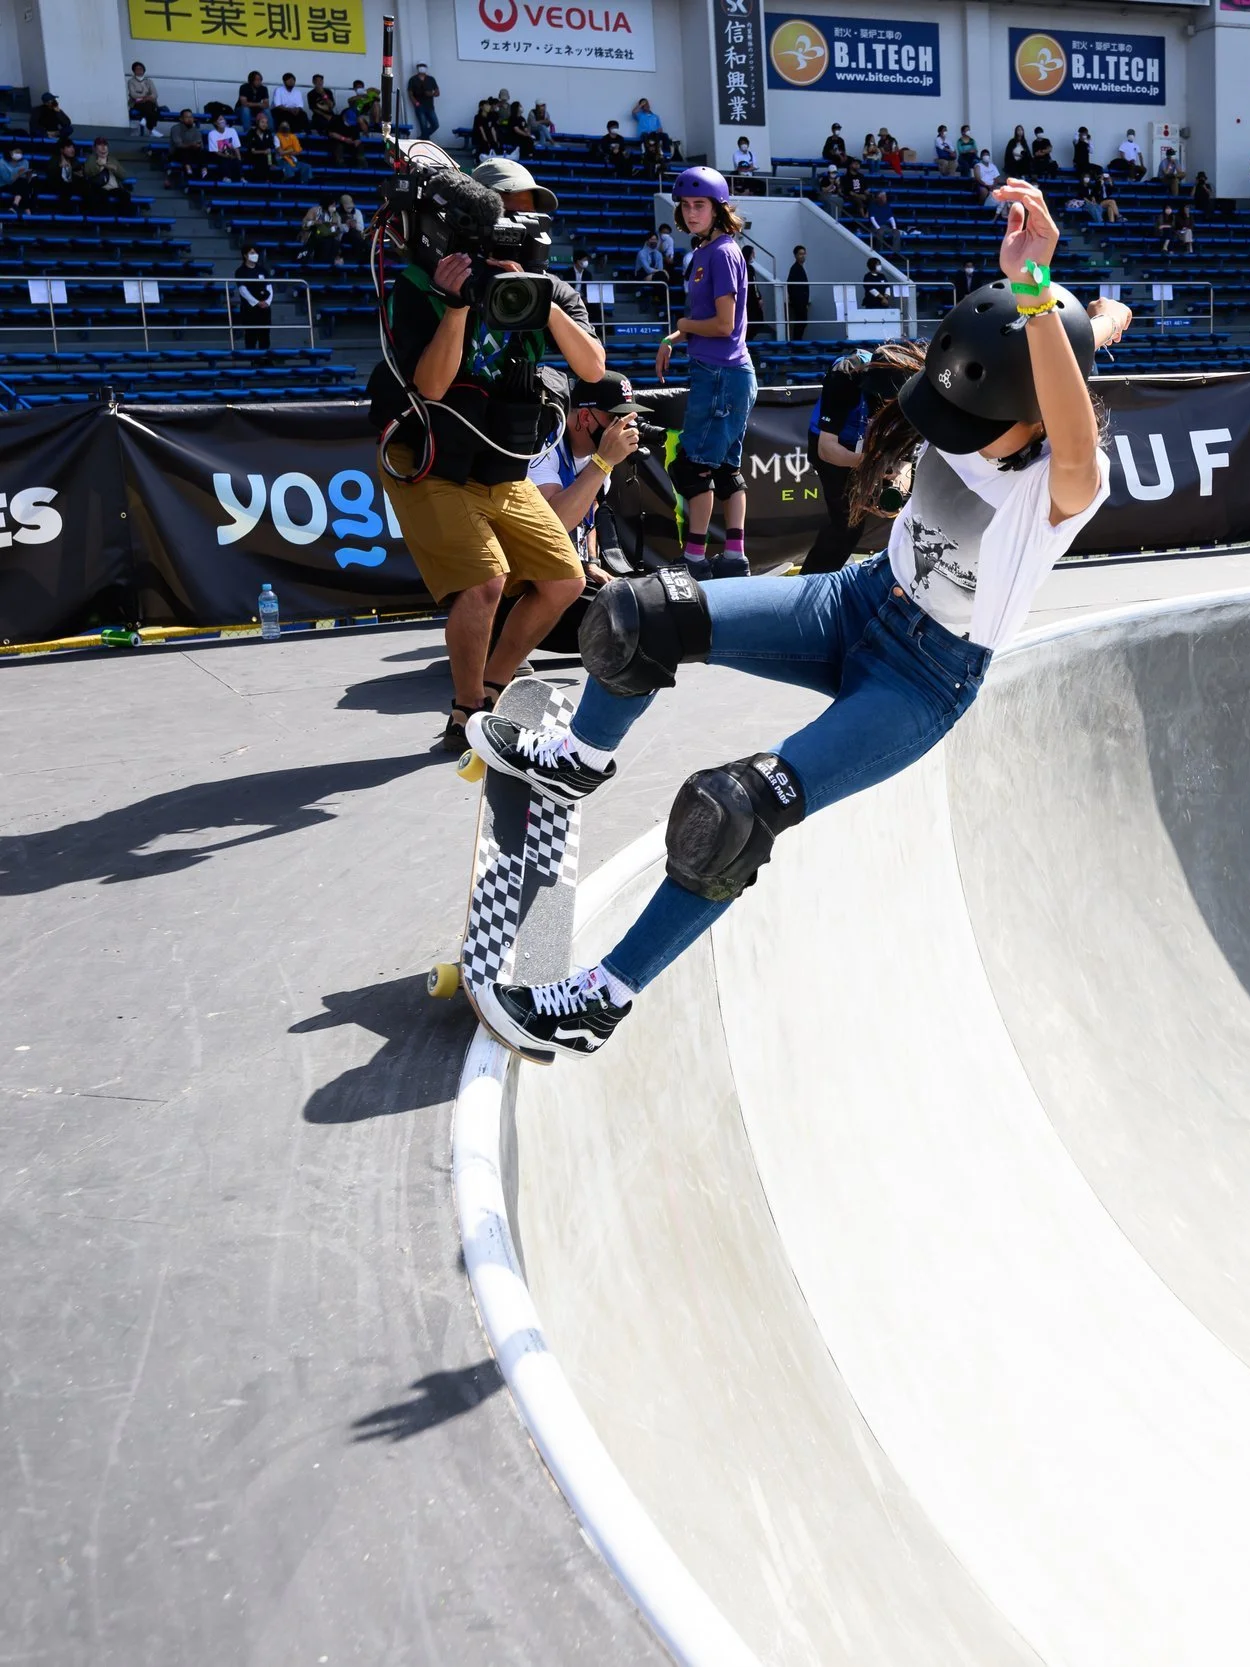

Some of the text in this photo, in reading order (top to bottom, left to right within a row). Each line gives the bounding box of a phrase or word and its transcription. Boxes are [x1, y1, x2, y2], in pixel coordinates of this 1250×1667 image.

[143, 0, 352, 45] 千葉測器
[523, 4, 633, 34] VEOLIA
[480, 39, 635, 61] ヴェオリア・ジェネッツ株式会社
[834, 41, 934, 72] B.I.TECH
[724, 20, 749, 122] 信和興業
[835, 72, 934, 87] www.bitech.co.jp
[1071, 53, 1160, 83] B.I.TECH
[1072, 82, 1160, 96] www.bitech.co.jp
[1113, 427, 1233, 501] UF
[774, 785, 790, 805] PADS
